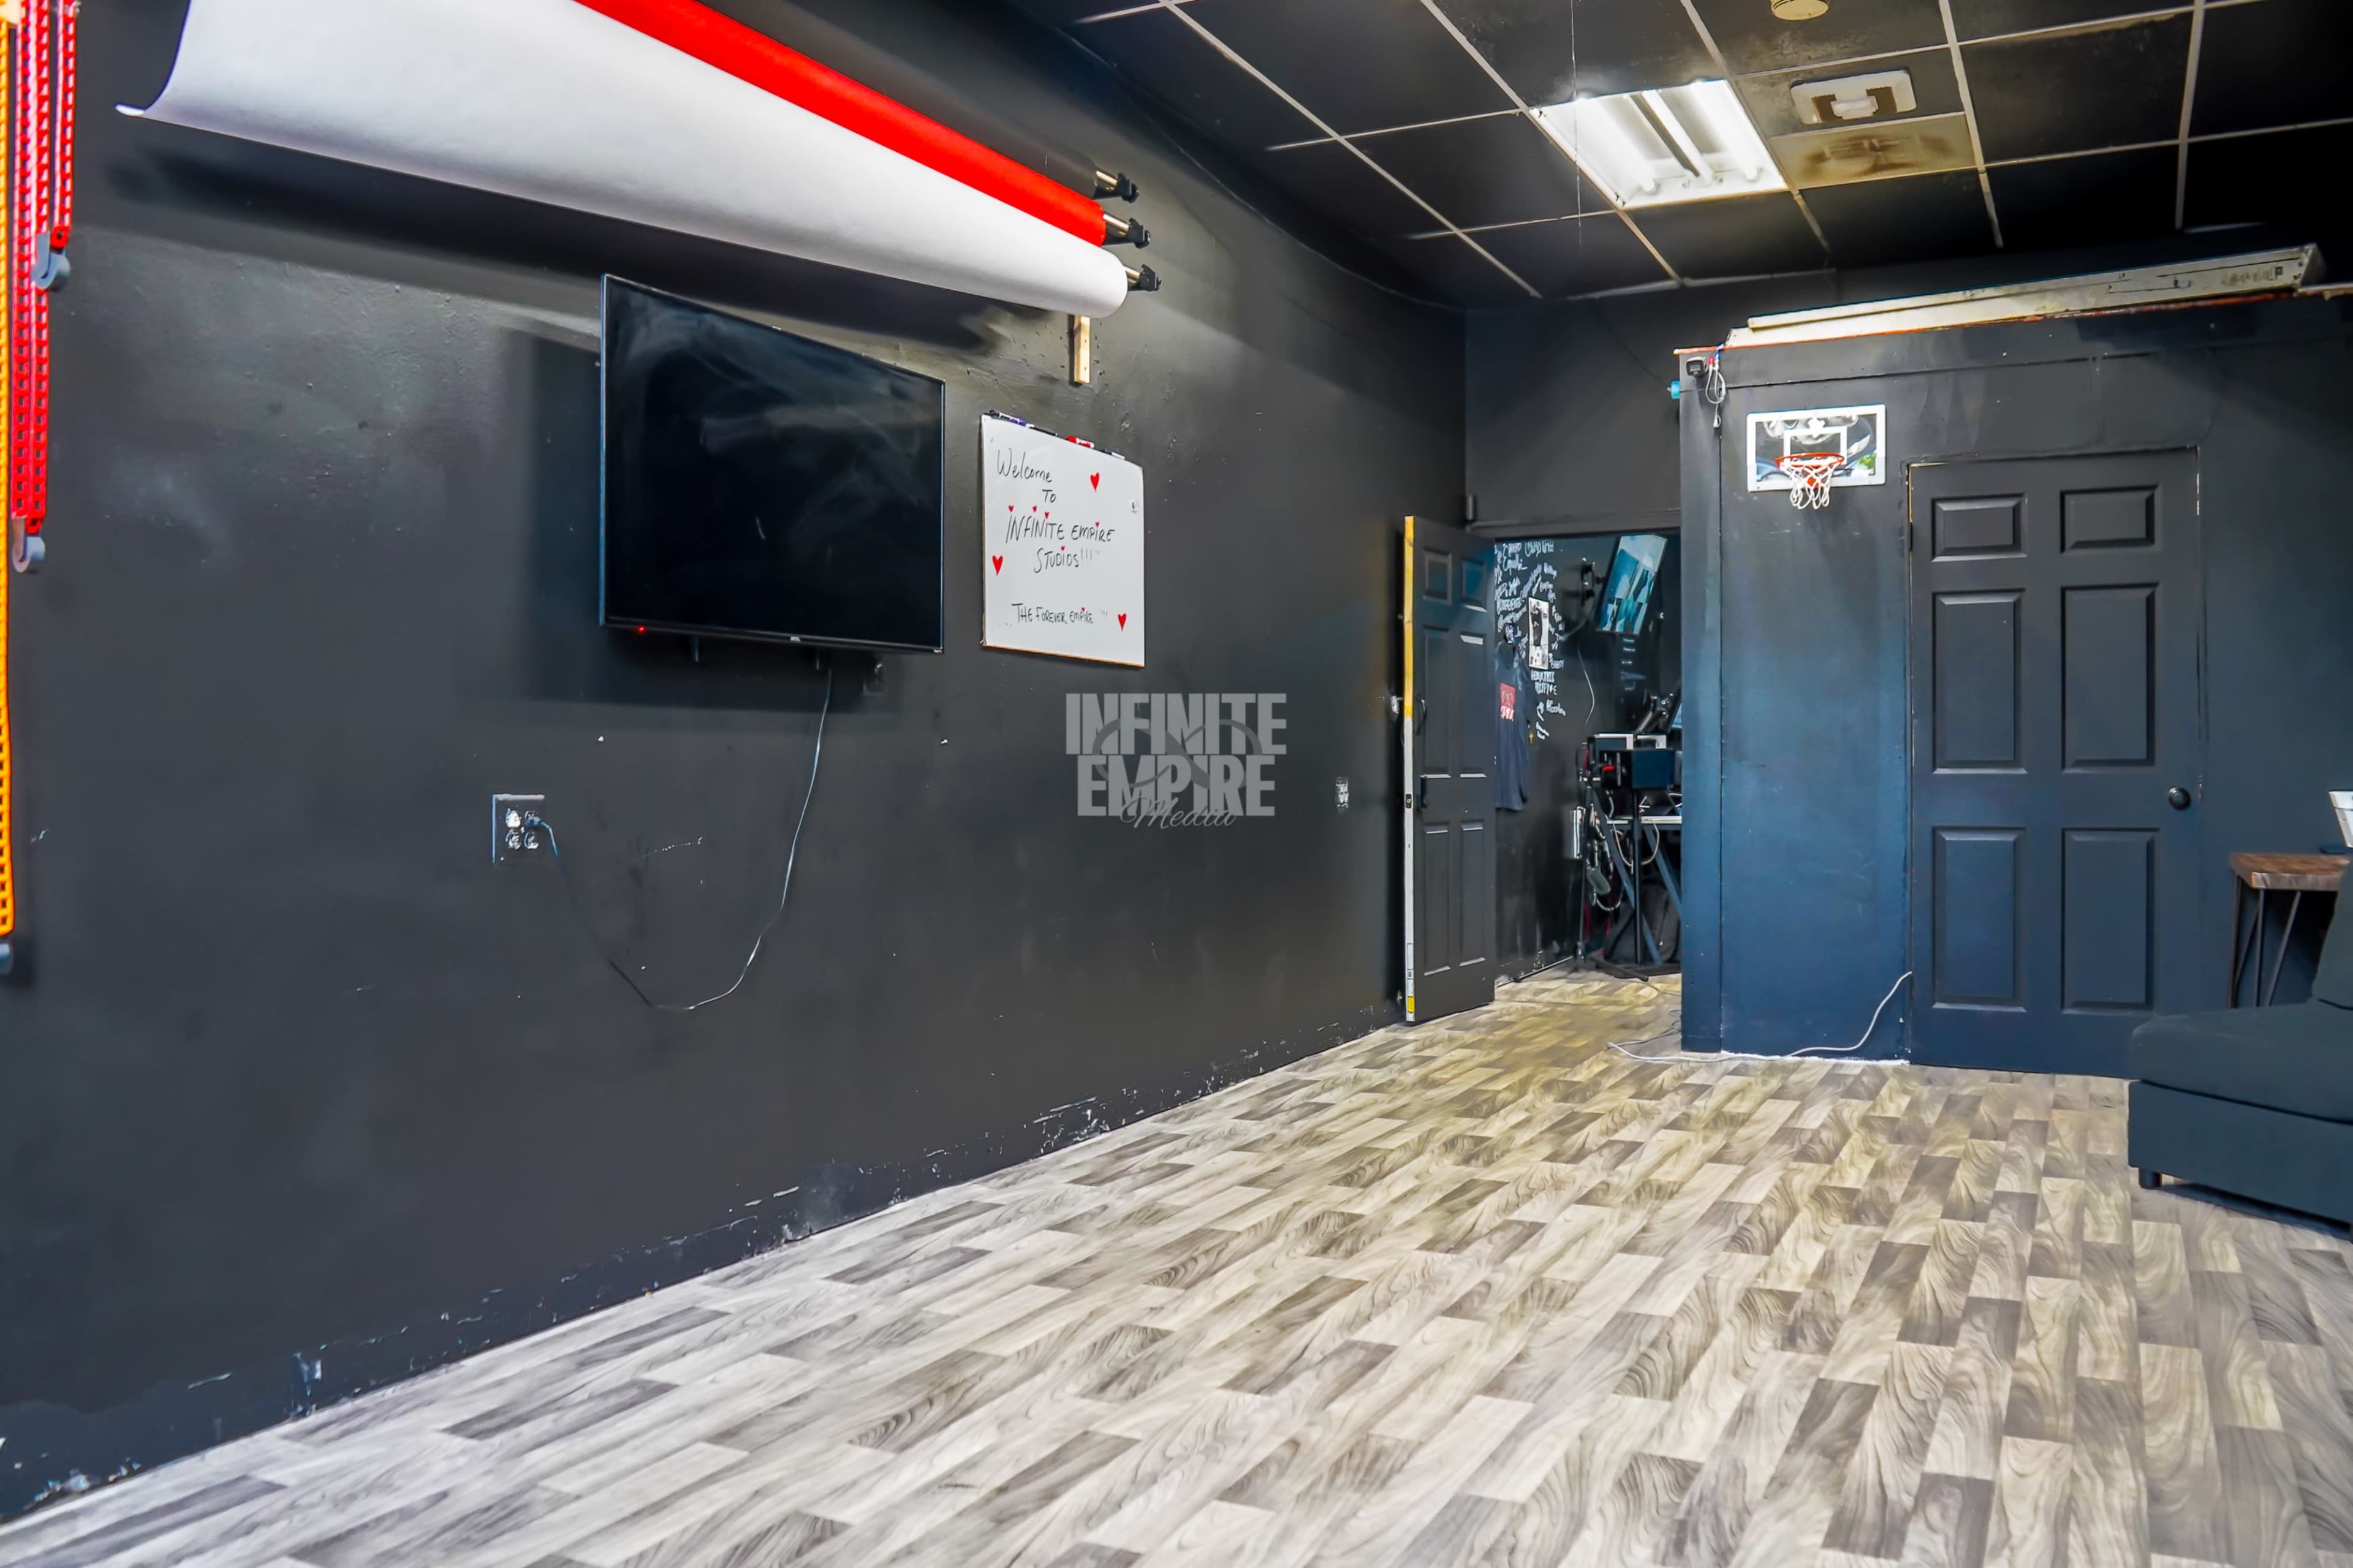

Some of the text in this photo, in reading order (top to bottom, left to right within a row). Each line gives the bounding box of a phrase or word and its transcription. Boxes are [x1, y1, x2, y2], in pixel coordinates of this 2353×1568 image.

[997, 447, 1053, 483] Welcome
[1006, 514, 1065, 544] INFINITE
[1011, 602, 1033, 623] THE
[1036, 606, 1068, 624] FOREVER
